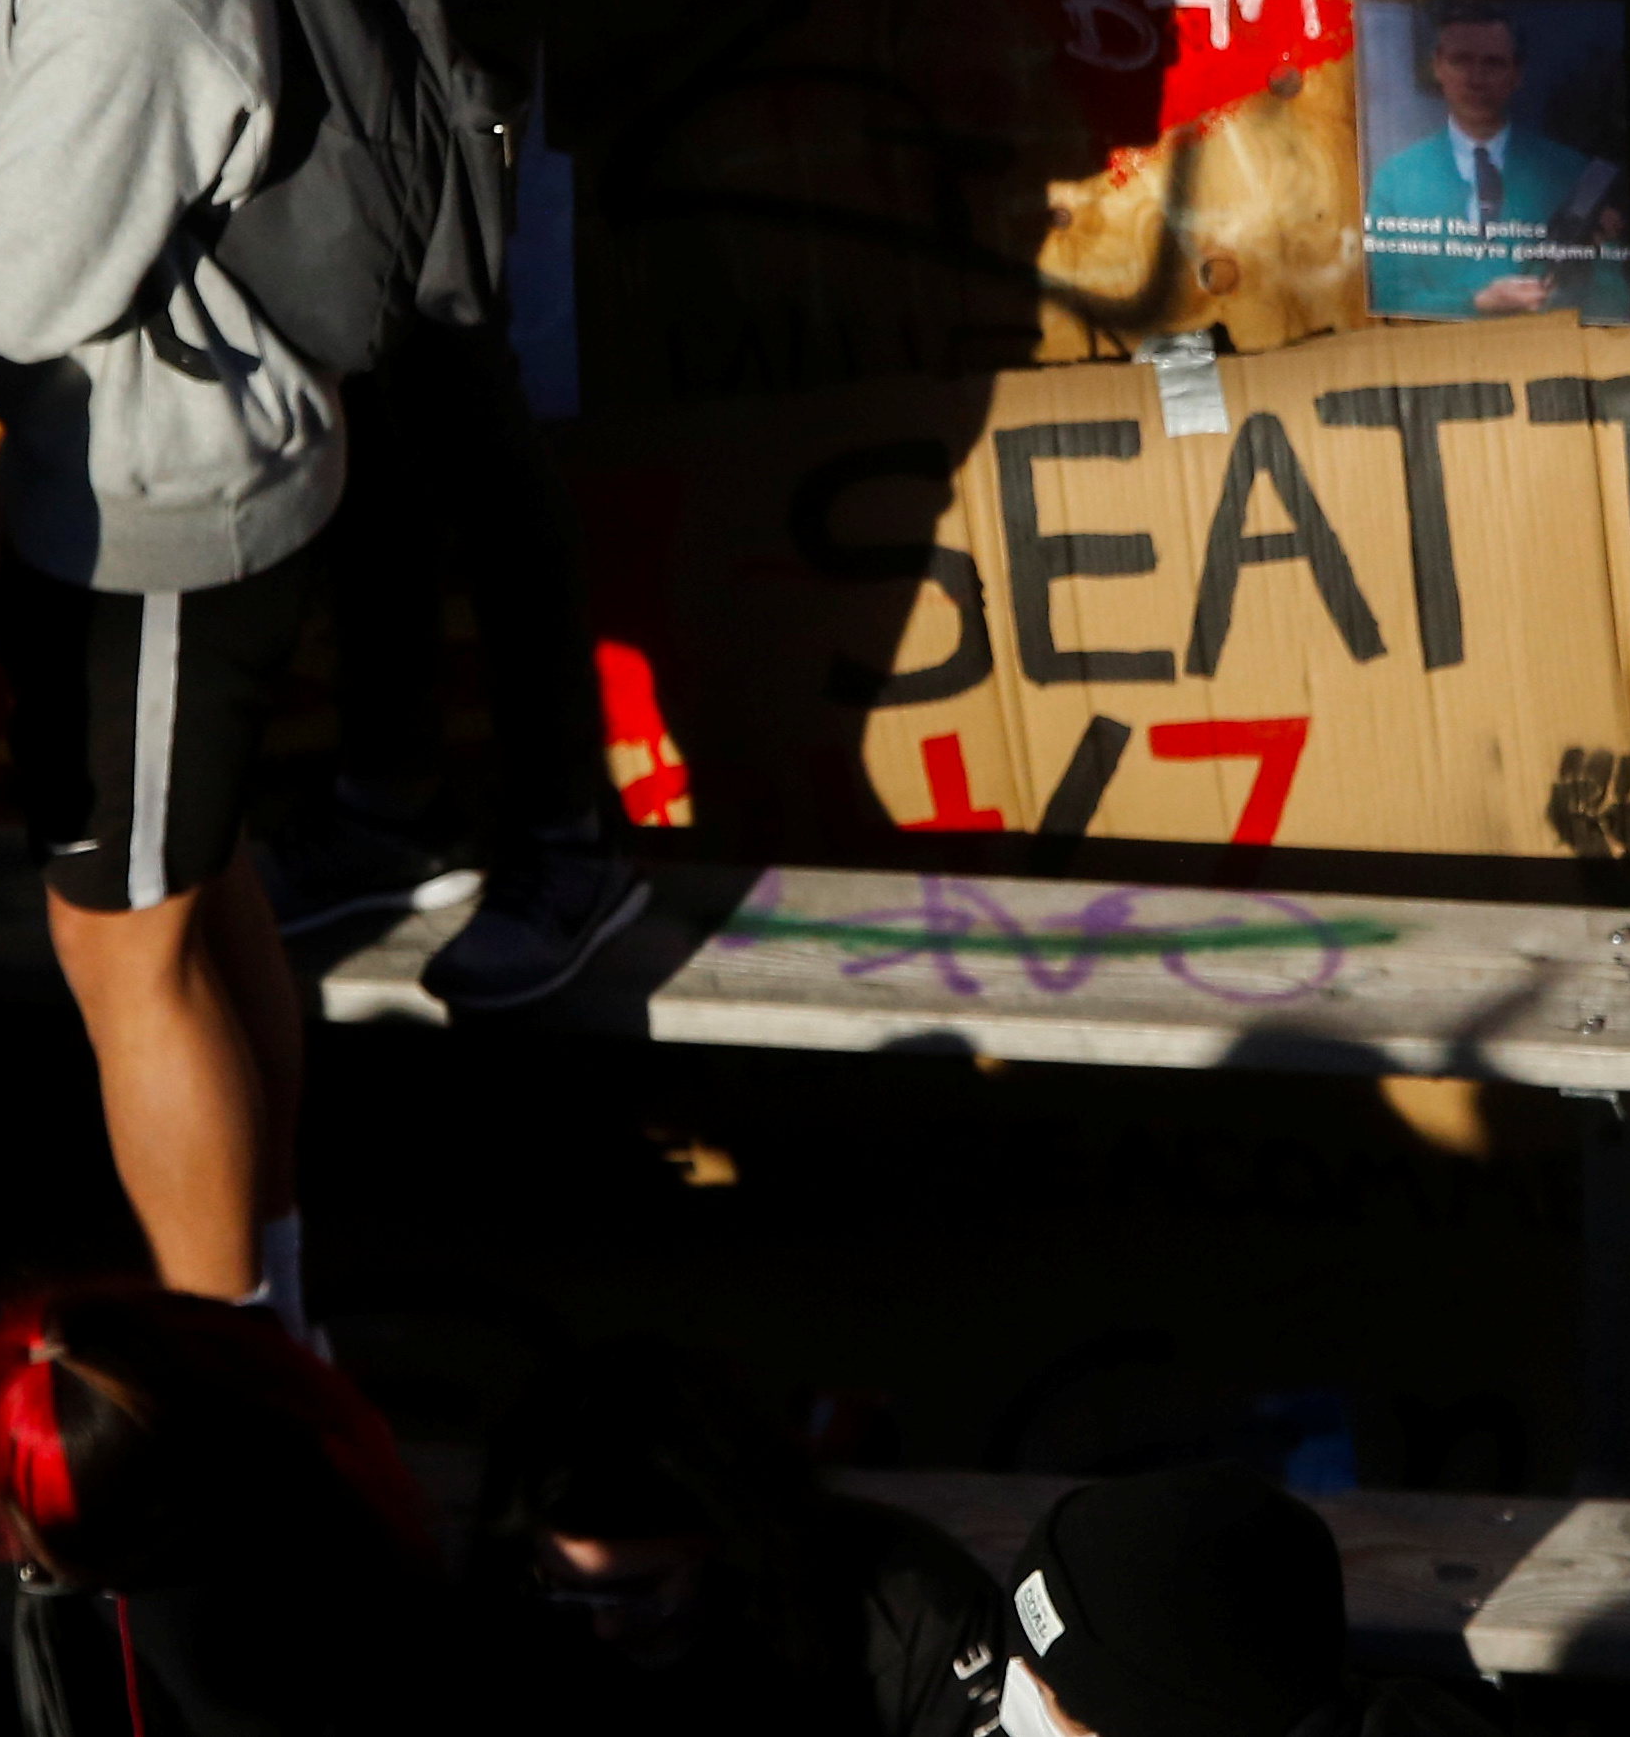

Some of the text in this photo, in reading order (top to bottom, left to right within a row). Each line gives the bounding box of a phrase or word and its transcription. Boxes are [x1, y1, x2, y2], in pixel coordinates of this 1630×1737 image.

[1377, 216, 1442, 235] record
[1447, 218, 1481, 236] the
[1485, 220, 1547, 239] police
[1363, 238, 1441, 256] Because
[1445, 240, 1507, 260] they're
[1512, 244, 1596, 262] goddamn
